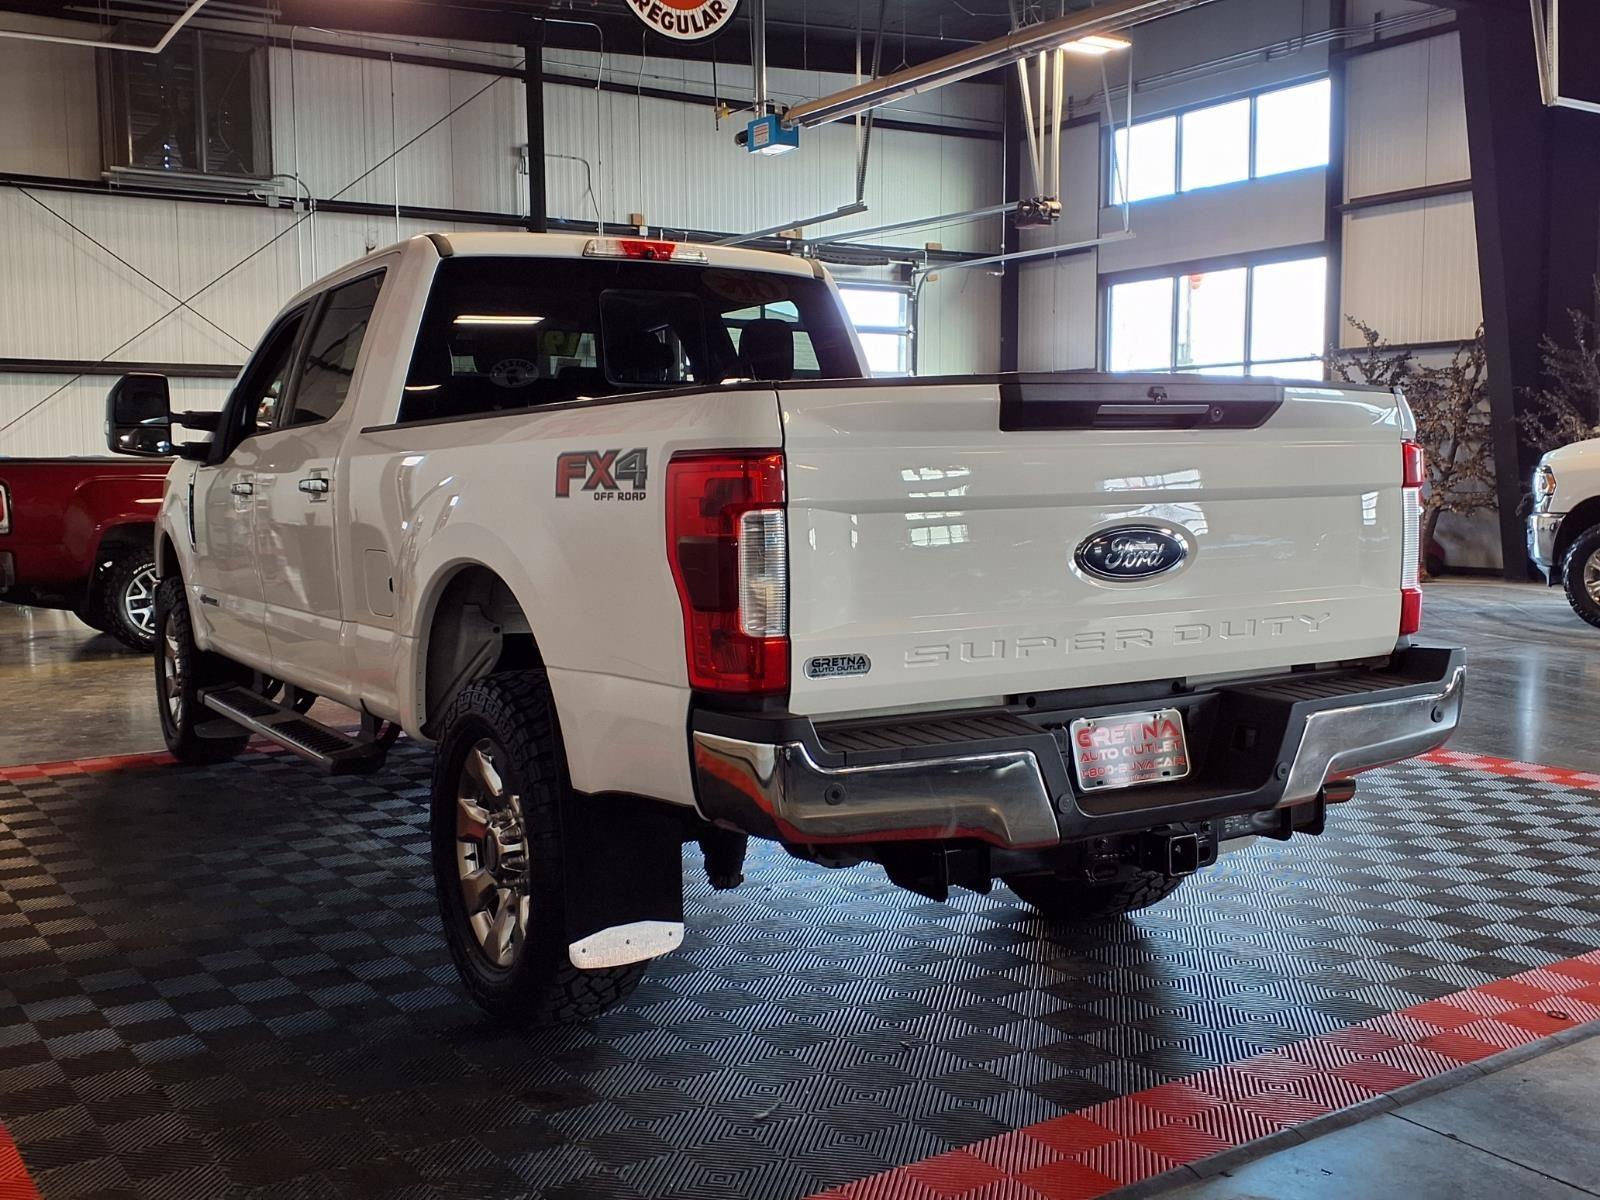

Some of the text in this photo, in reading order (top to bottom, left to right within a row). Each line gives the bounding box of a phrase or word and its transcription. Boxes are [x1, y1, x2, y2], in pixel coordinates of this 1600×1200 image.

[631, 0, 727, 34] REGULAR
[555, 447, 648, 498] FX4
[593, 491, 646, 501] OFF ROAD
[1105, 536, 1165, 570] Ford
[903, 612, 1330, 668] SUPER DUTY
[811, 656, 866, 668] GRETNA
[837, 664, 866, 672] OUTLET
[1076, 719, 1180, 748] GRETNA
[1080, 740, 1182, 763] AUTO OUTLET
[1081, 756, 1186, 779] 1-800-BUYACAR
